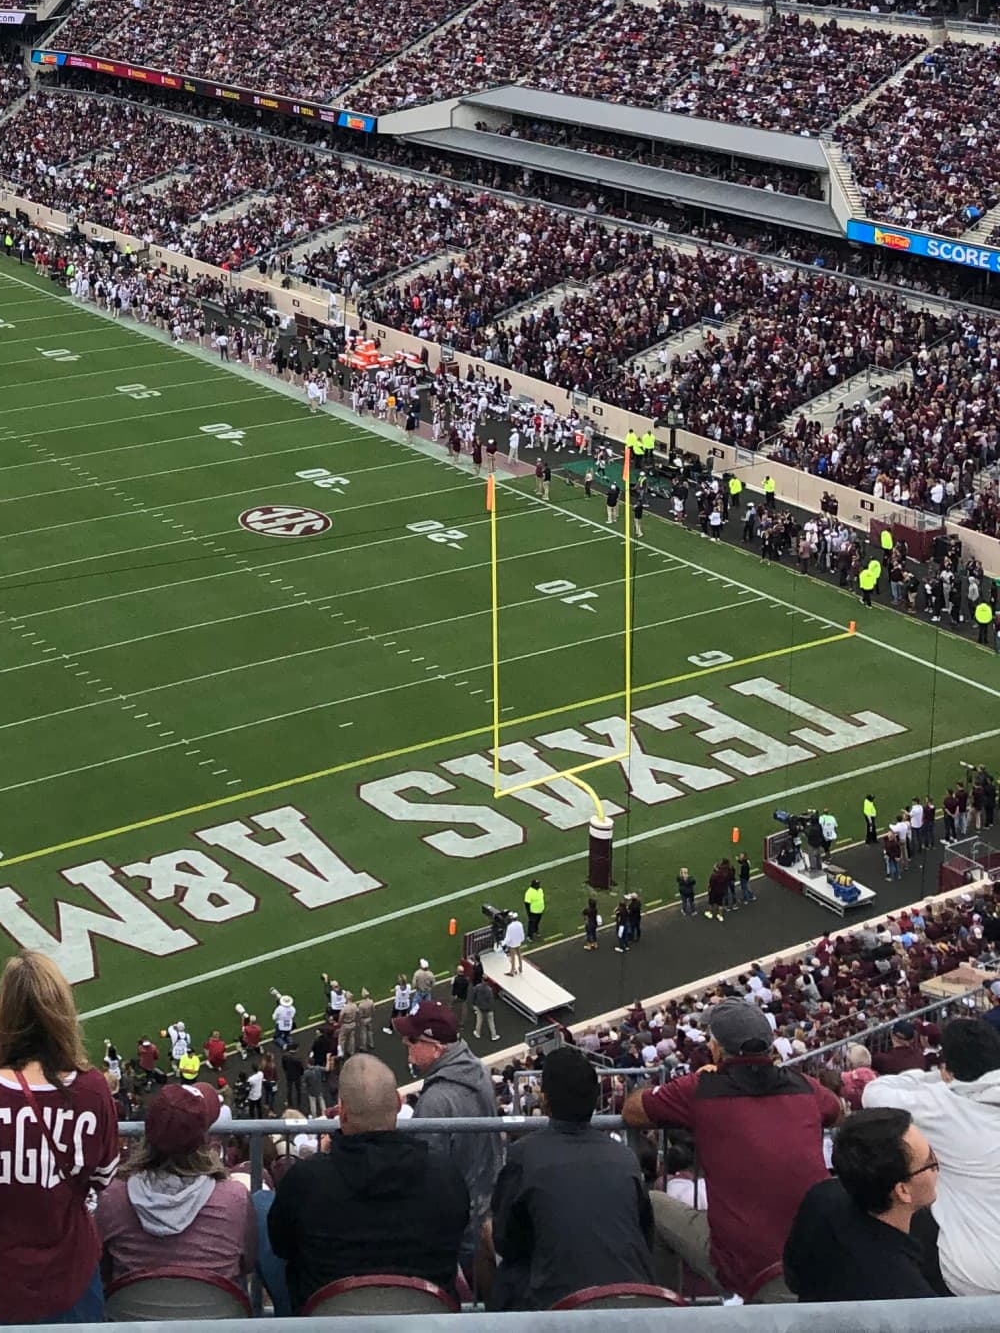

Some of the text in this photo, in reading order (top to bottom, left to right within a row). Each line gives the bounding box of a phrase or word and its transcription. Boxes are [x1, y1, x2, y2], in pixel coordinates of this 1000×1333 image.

[926, 239, 991, 269] SCORE
[41, 348, 82, 362] 40
[115, 383, 162, 401] 50
[199, 423, 246, 441] 40
[295, 468, 350, 491] 30
[406, 520, 469, 543] 20
[534, 578, 599, 606] 10
[358, 676, 910, 859] TEXAS
